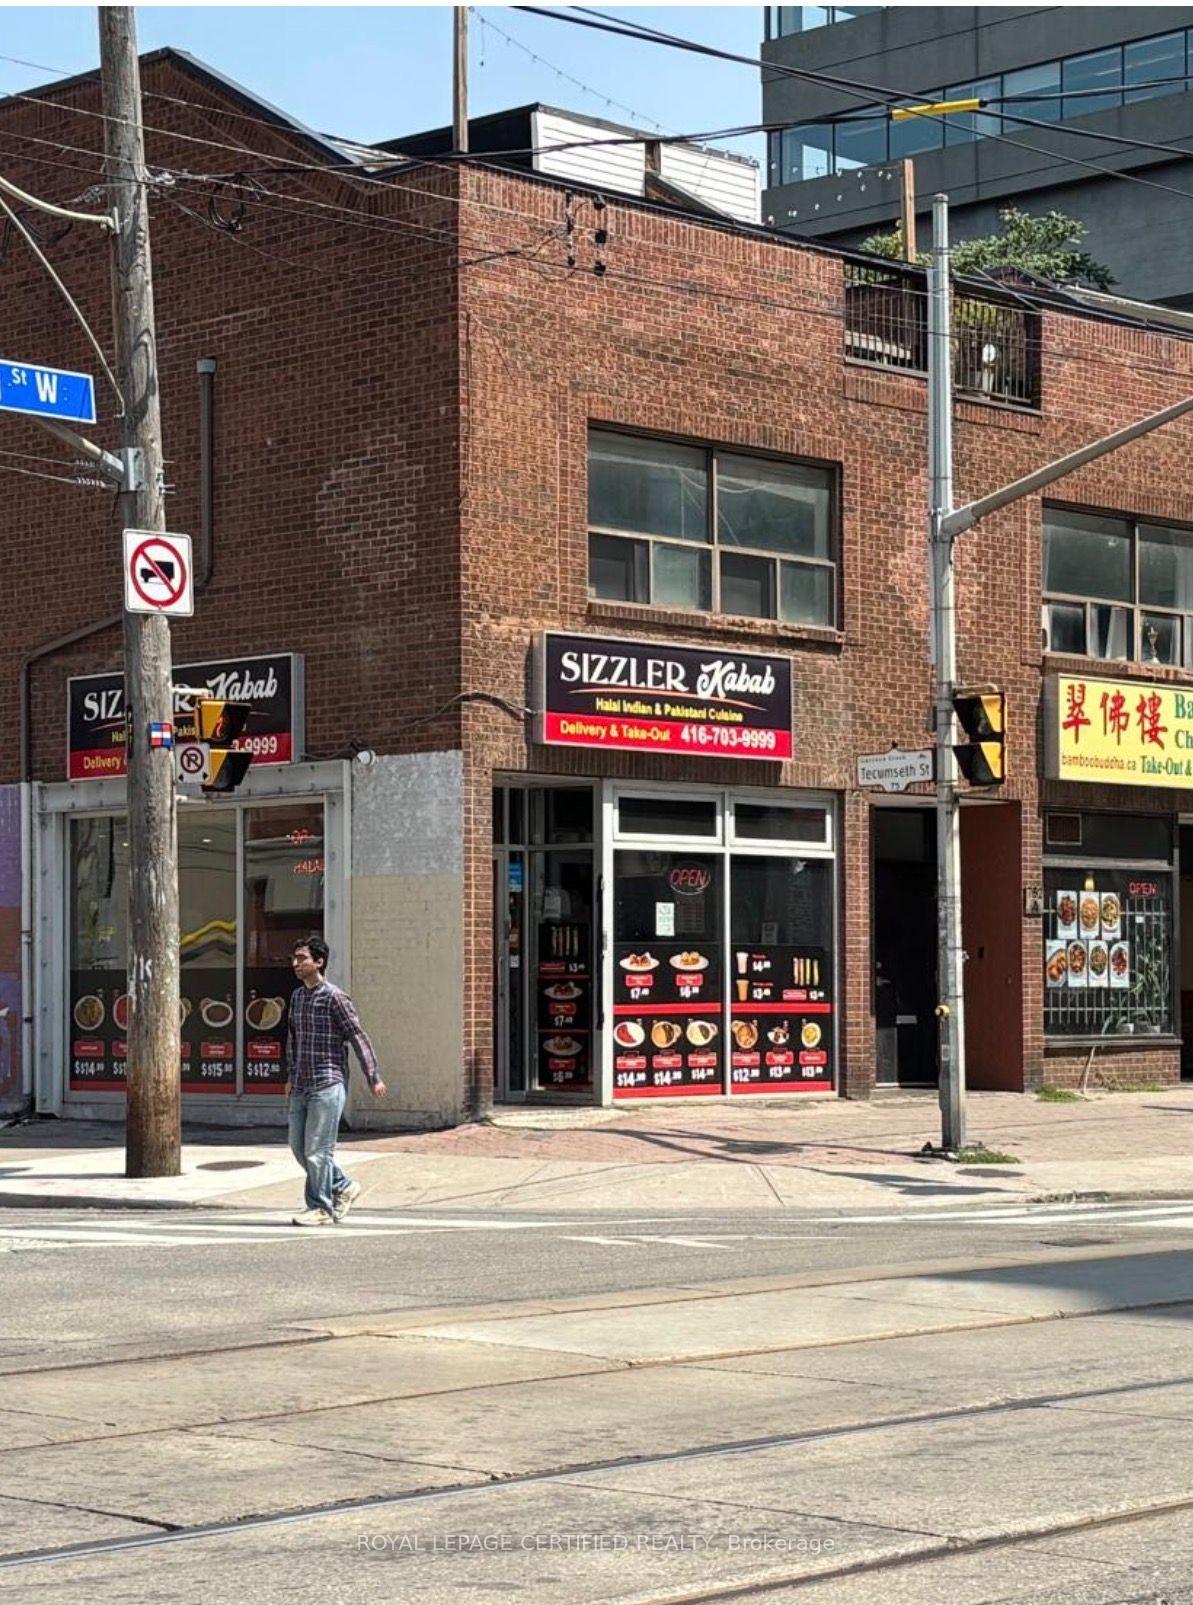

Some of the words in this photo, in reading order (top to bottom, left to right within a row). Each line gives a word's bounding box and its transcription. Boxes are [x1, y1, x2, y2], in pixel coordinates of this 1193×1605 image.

[12, 368, 27, 386] St
[35, 373, 58, 404] W
[206, 666, 278, 700] Kabab
[560, 651, 690, 692] SIZZLER
[696, 660, 776, 699] Kabab
[596, 697, 621, 712] Halal
[623, 700, 652, 715] Indian
[654, 703, 662, 716] &
[664, 704, 707, 720] Pakistani
[708, 708, 743, 722] Cuisine
[1062, 684, 1168, 750] 翠佛樓
[560, 720, 606, 739] Delivery
[610, 725, 618, 738] &
[621, 725, 671, 741] Take-Out
[680, 725, 776, 750] 416-703-9999
[83, 756, 122, 771] Delivery
[861, 764, 917, 780] Tecumseth
[919, 763, 930, 776] St
[1062, 754, 1137, 771] bamboobuddha.ca
[1140, 755, 1184, 776] Take-Out
[1185, 759, 1193, 777] &
[670, 869, 707, 887] OPEN
[1129, 882, 1158, 896] OPEN
